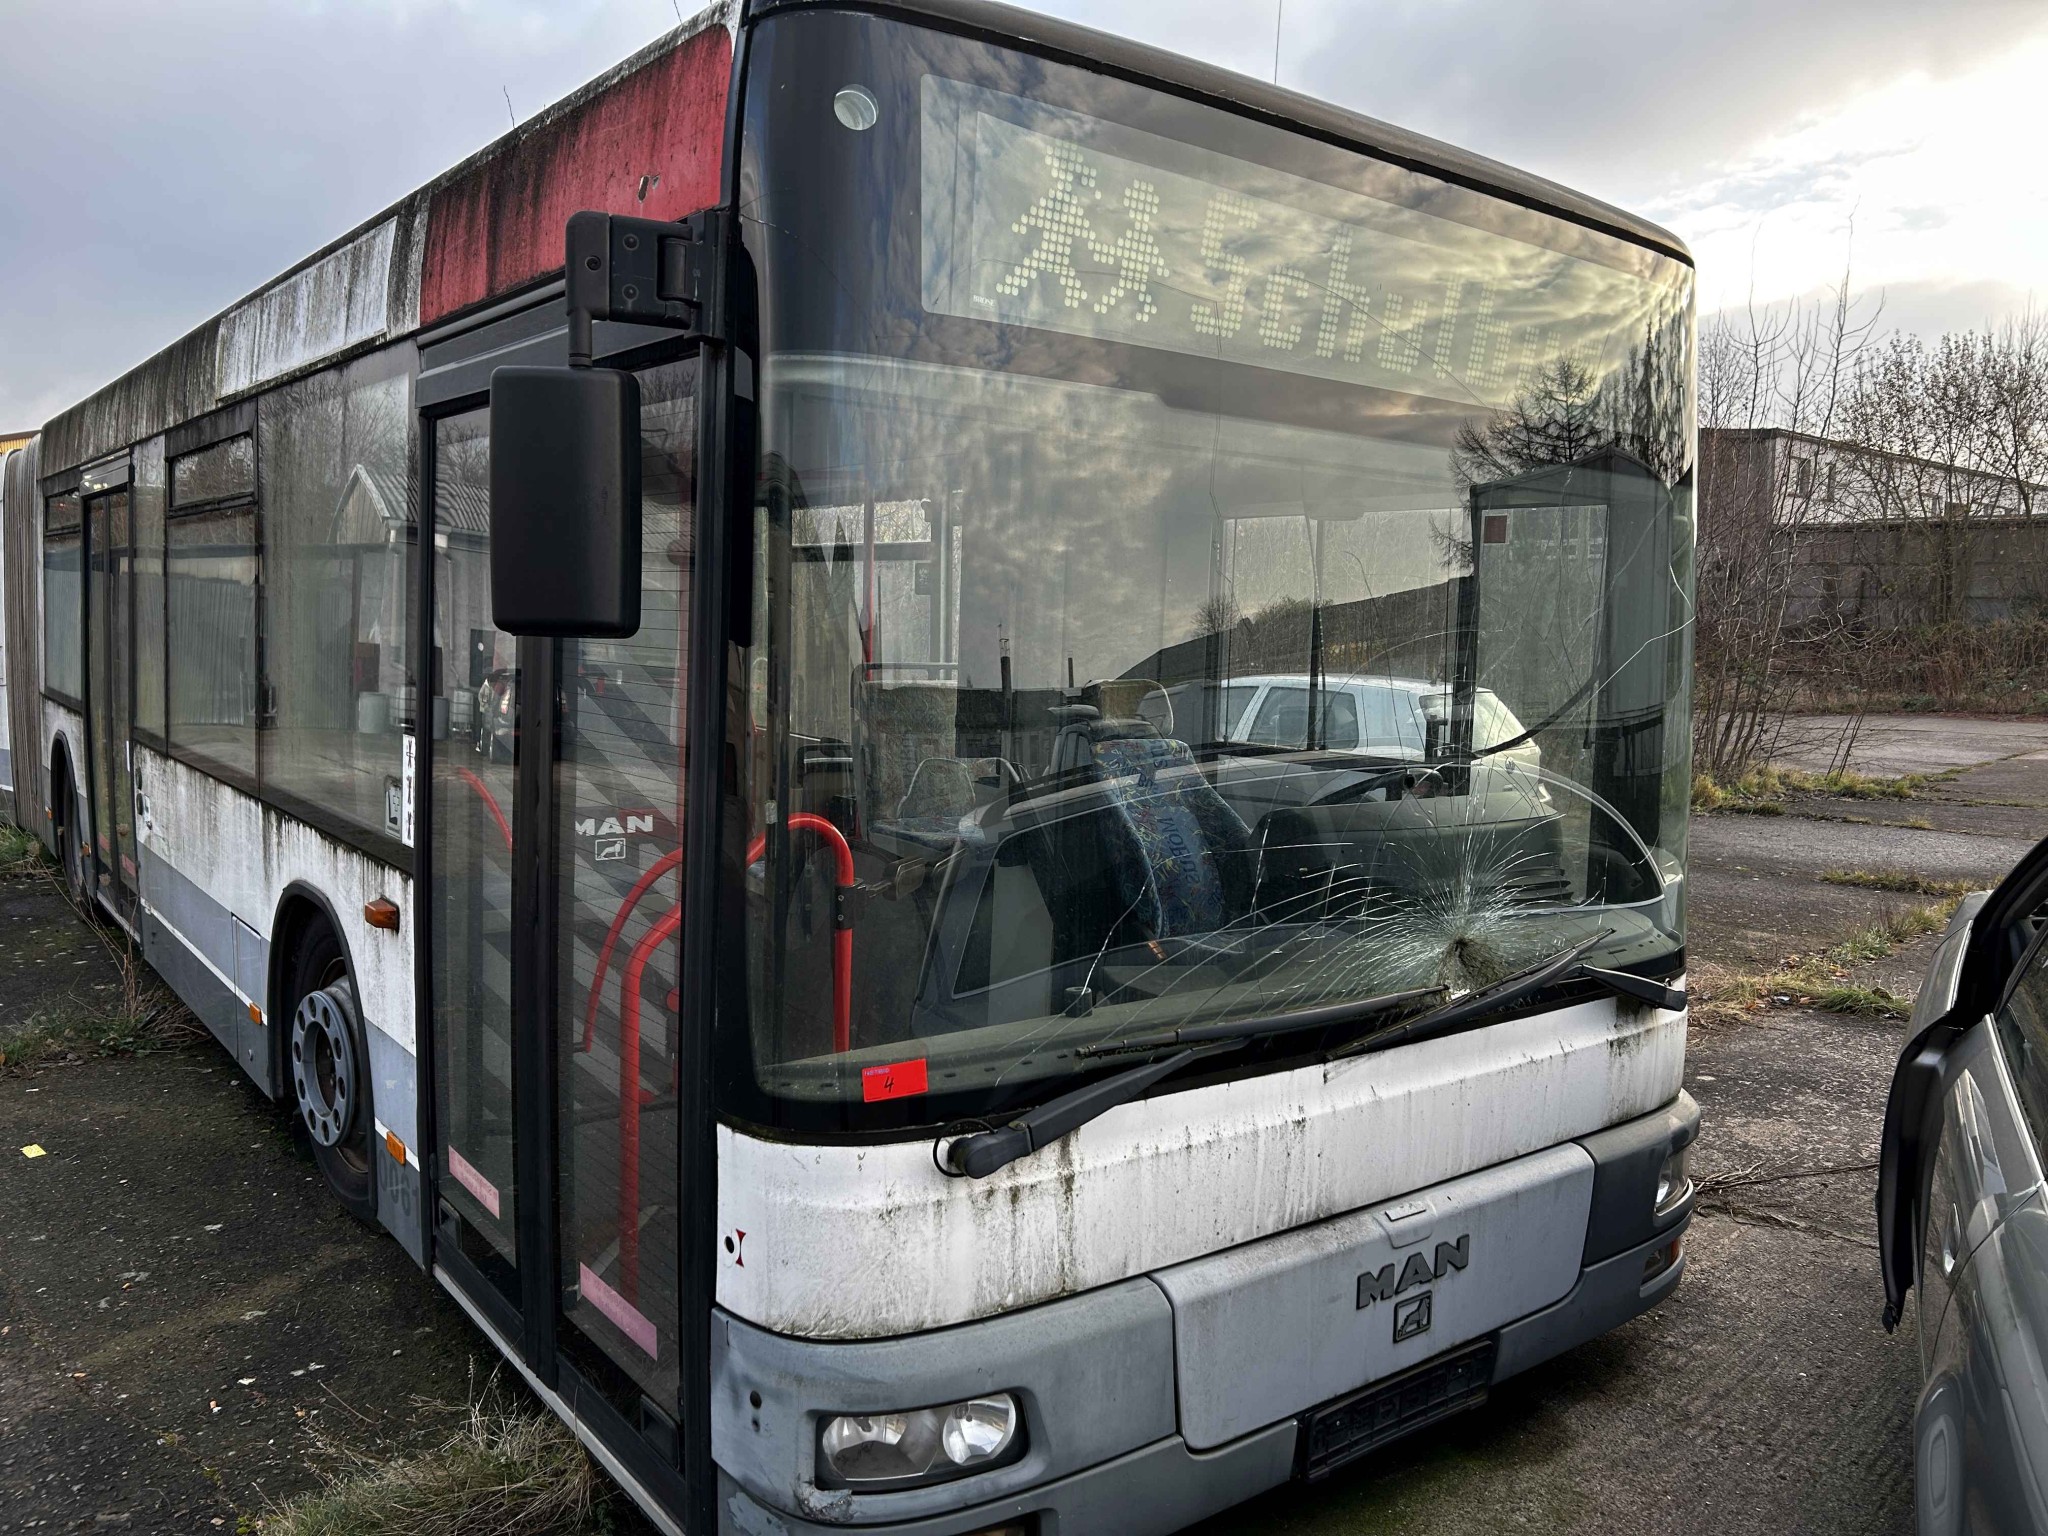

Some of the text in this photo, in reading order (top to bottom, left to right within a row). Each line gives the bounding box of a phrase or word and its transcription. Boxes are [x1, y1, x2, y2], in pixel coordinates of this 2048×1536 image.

[575, 814, 653, 836] MAN
[883, 1076, 895, 1093] 4
[1356, 1233, 1470, 1311] MAN
